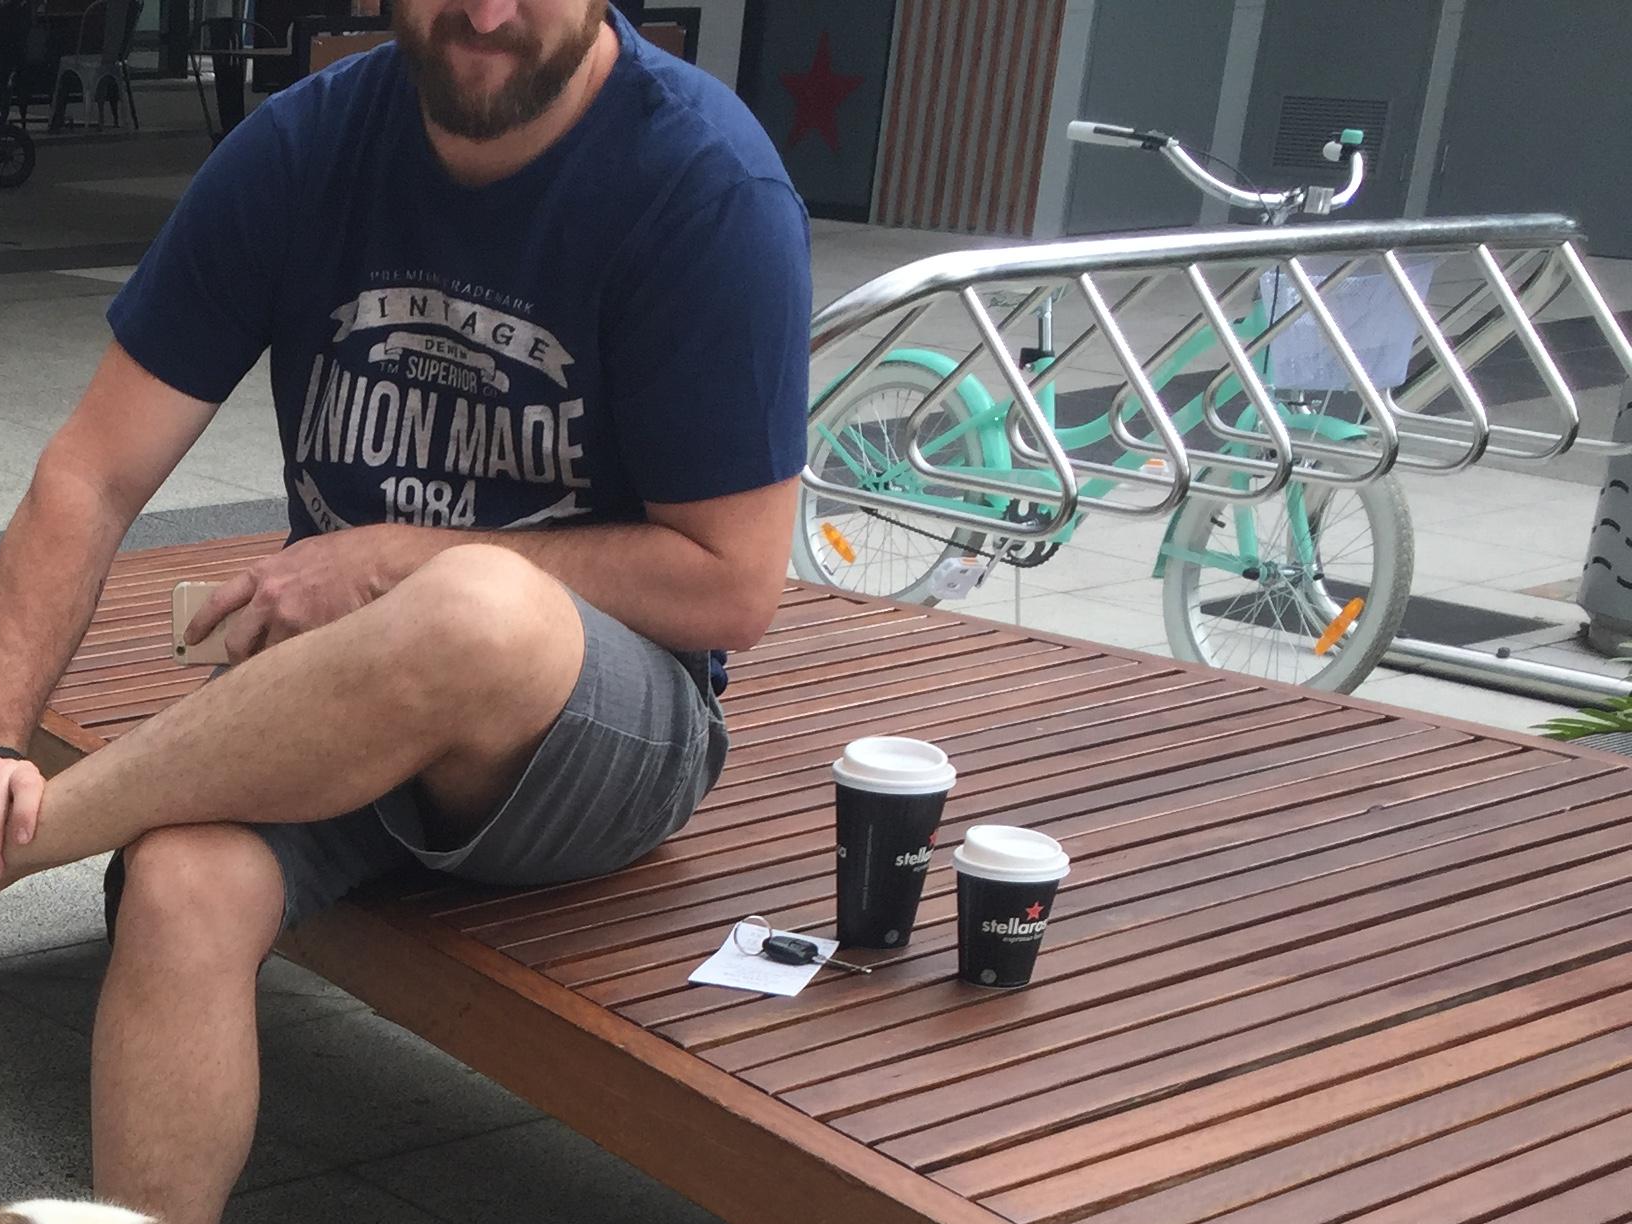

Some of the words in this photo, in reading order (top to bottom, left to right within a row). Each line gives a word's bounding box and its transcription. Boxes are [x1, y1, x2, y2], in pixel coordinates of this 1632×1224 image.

[406, 355, 478, 395] SUPERIOR
[295, 353, 438, 468] UNION
[444, 397, 592, 489] MADE
[379, 476, 477, 528] 1984
